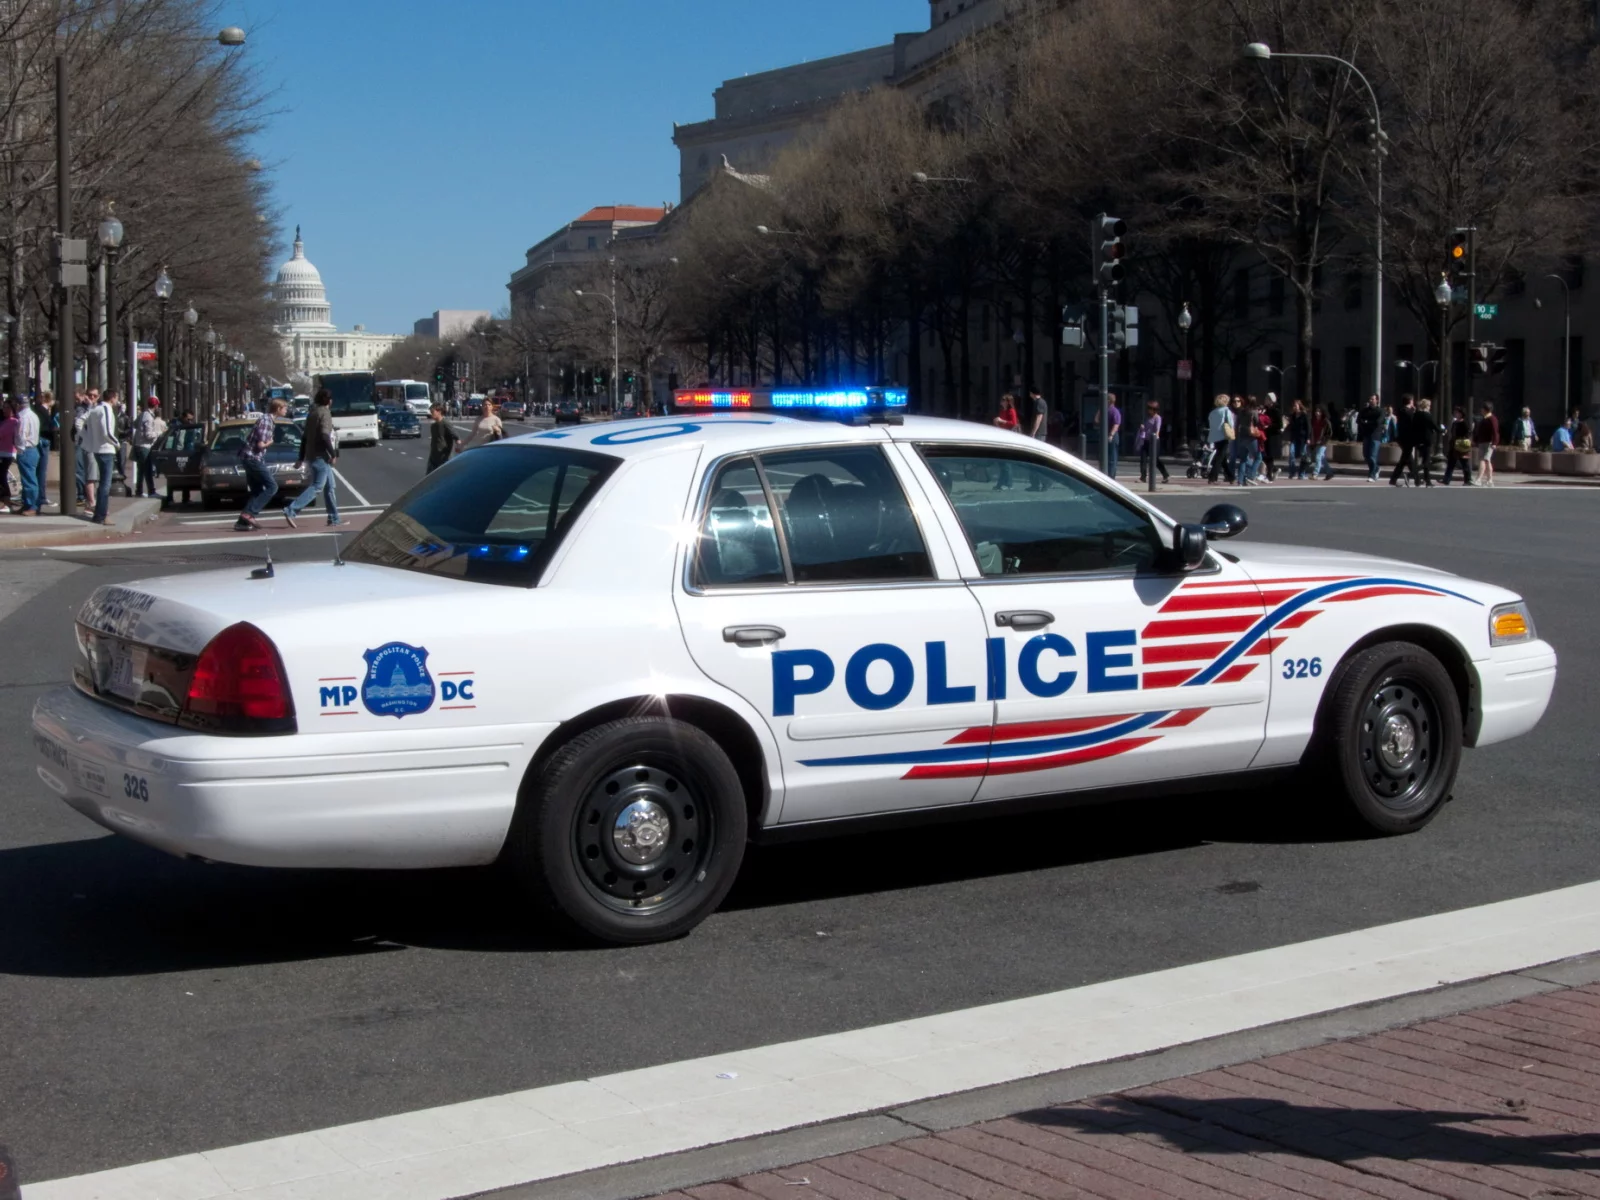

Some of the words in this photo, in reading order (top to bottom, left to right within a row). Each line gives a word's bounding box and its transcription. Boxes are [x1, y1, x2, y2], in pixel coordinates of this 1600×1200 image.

[1477, 305, 1485, 313] 10
[370, 646, 410, 679] METROPOLITAN
[410, 653, 426, 678] POLICE
[771, 629, 1139, 717] POLICE
[1282, 657, 1322, 679] 326
[320, 685, 358, 707] MP
[440, 679, 475, 701] DC
[381, 699, 418, 708] WASHINGTON
[123, 772, 150, 802] 326
